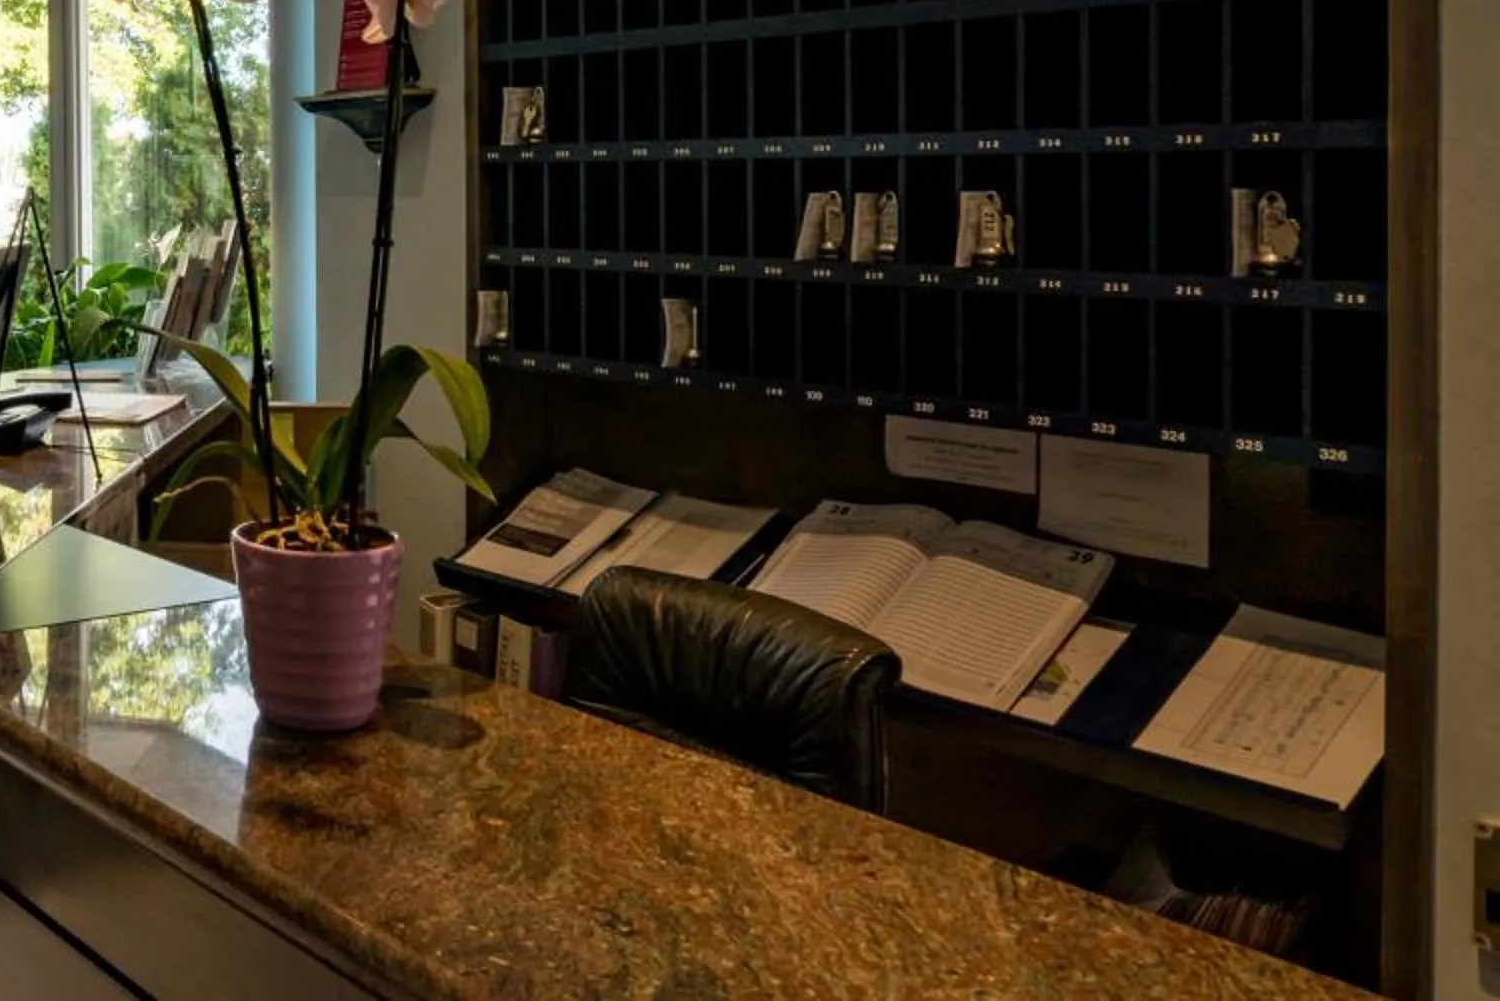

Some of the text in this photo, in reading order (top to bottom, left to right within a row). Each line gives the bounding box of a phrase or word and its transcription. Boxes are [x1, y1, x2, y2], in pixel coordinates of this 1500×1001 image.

[1251, 288, 1279, 300] 217
[1161, 429, 1186, 442] 324
[1235, 438, 1264, 452] 325
[1319, 447, 1348, 462] 326
[1067, 550, 1094, 565] 29
